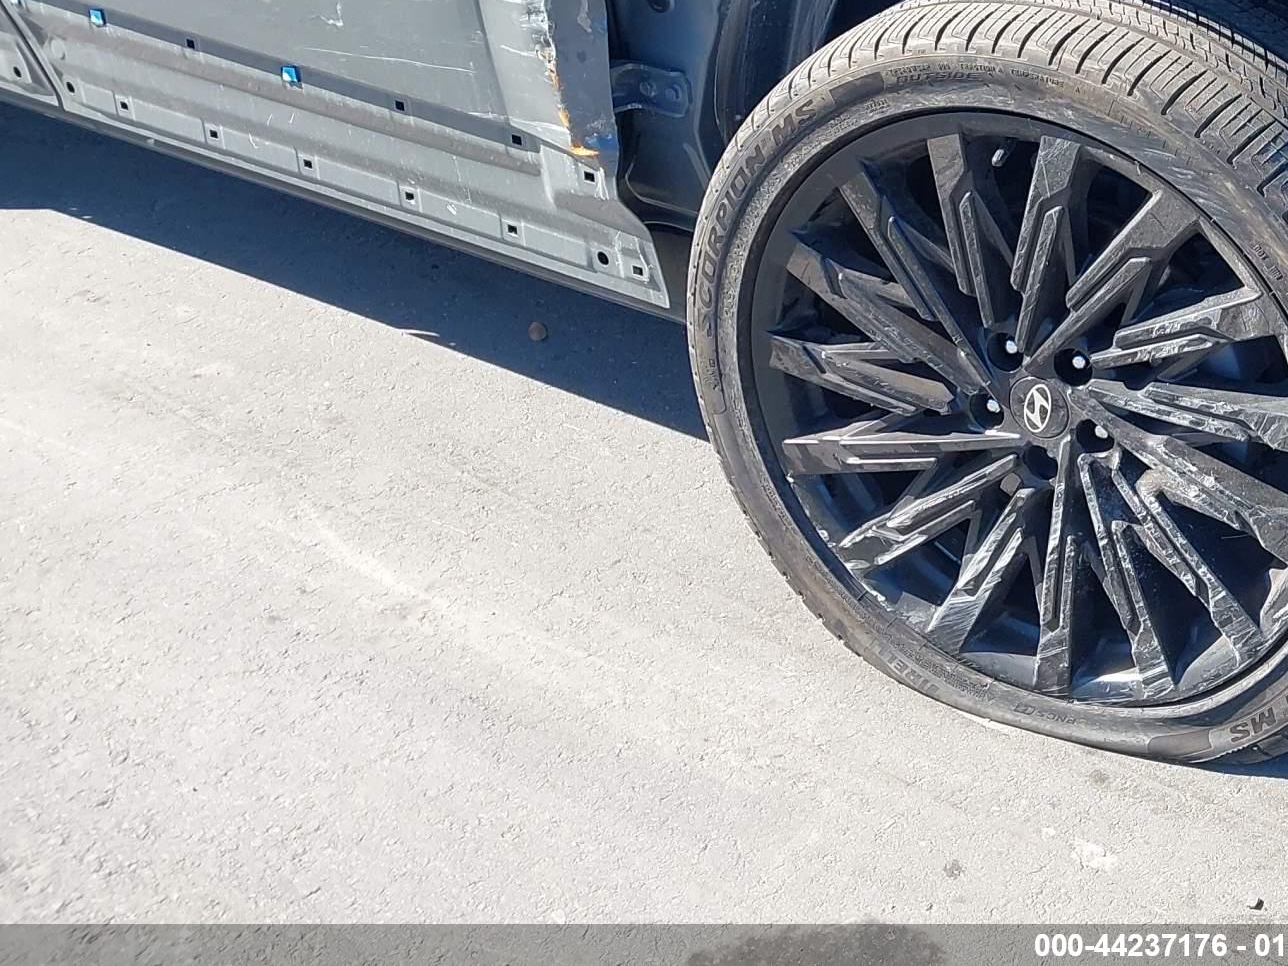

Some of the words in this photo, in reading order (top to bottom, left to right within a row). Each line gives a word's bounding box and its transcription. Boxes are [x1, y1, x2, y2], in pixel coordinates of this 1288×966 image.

[702, 145, 764, 338] SCORPION
[771, 99, 816, 146] MS
[1230, 707, 1277, 742] MS
